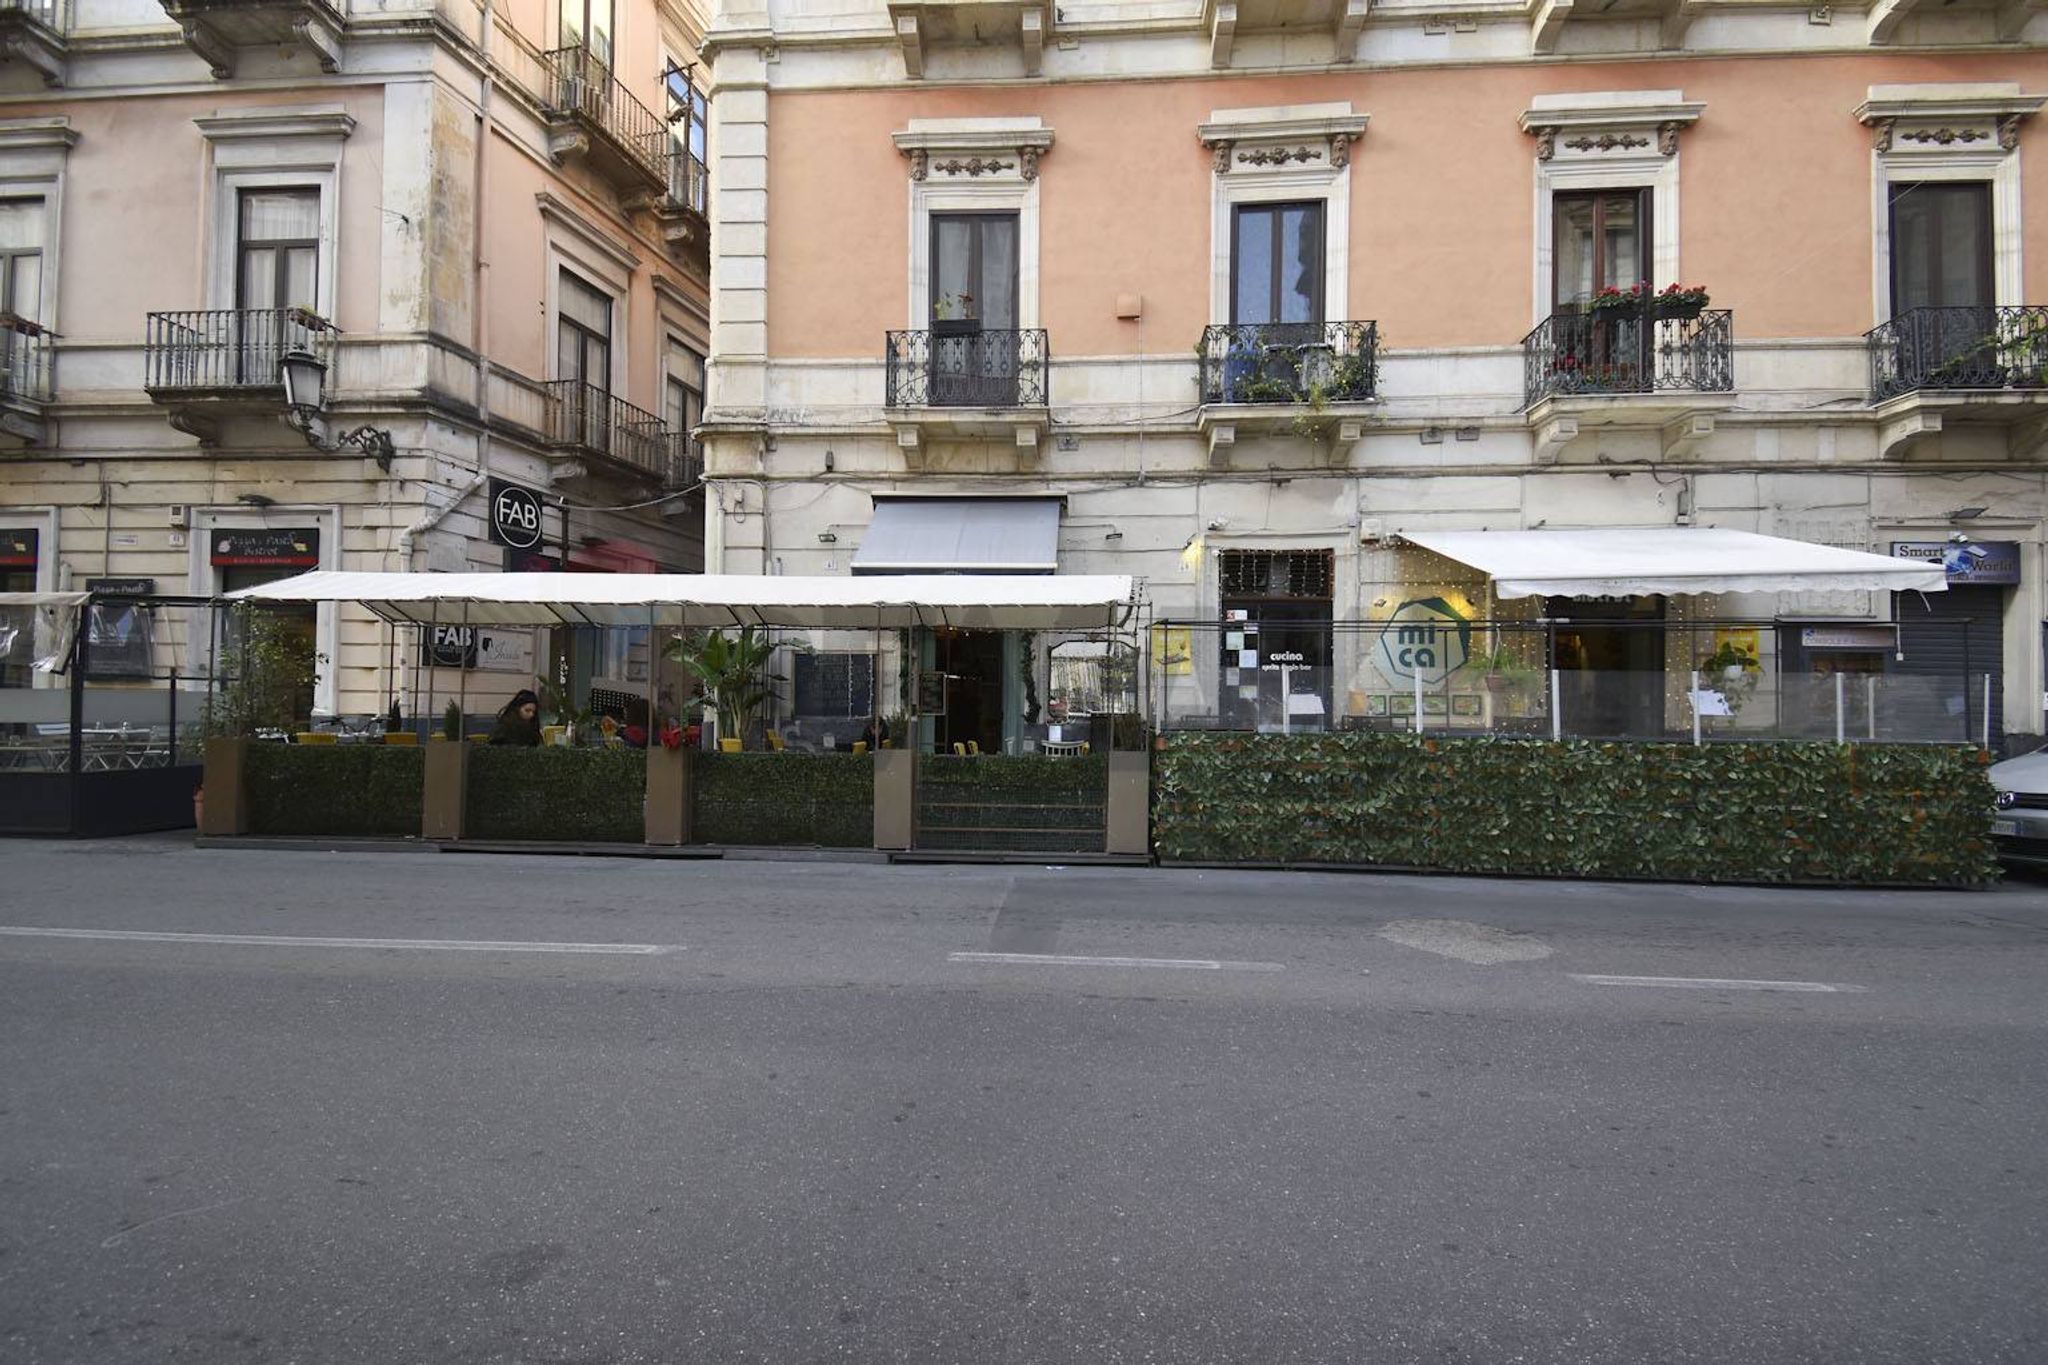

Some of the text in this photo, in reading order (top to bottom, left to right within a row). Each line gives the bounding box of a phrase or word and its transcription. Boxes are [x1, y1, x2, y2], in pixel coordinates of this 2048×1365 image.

[500, 497, 537, 529] FAB
[1899, 545, 1946, 558] Smart
[1971, 559, 2013, 572] World
[434, 626, 472, 647] FAB
[1269, 650, 1304, 661] cucina
[1398, 647, 1435, 668] ca
